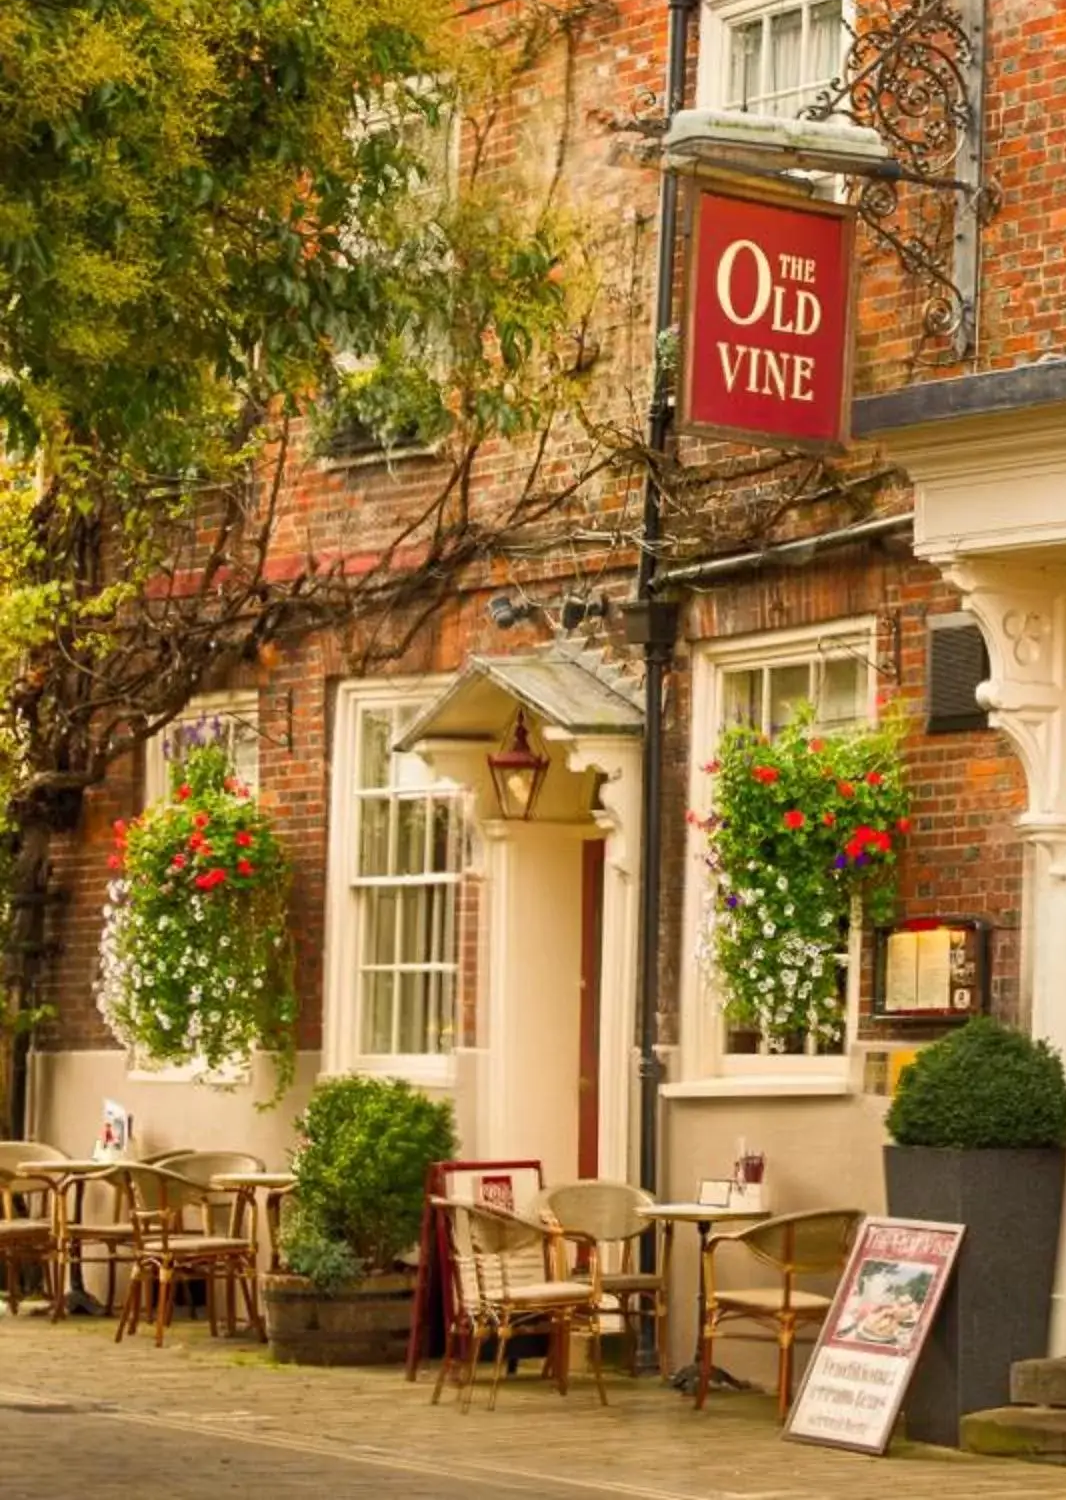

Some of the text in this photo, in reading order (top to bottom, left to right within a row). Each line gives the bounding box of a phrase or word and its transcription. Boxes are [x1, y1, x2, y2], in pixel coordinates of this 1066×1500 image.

[717, 239, 822, 336] OLD
[779, 253, 816, 284] THE
[716, 341, 815, 401] VINE
